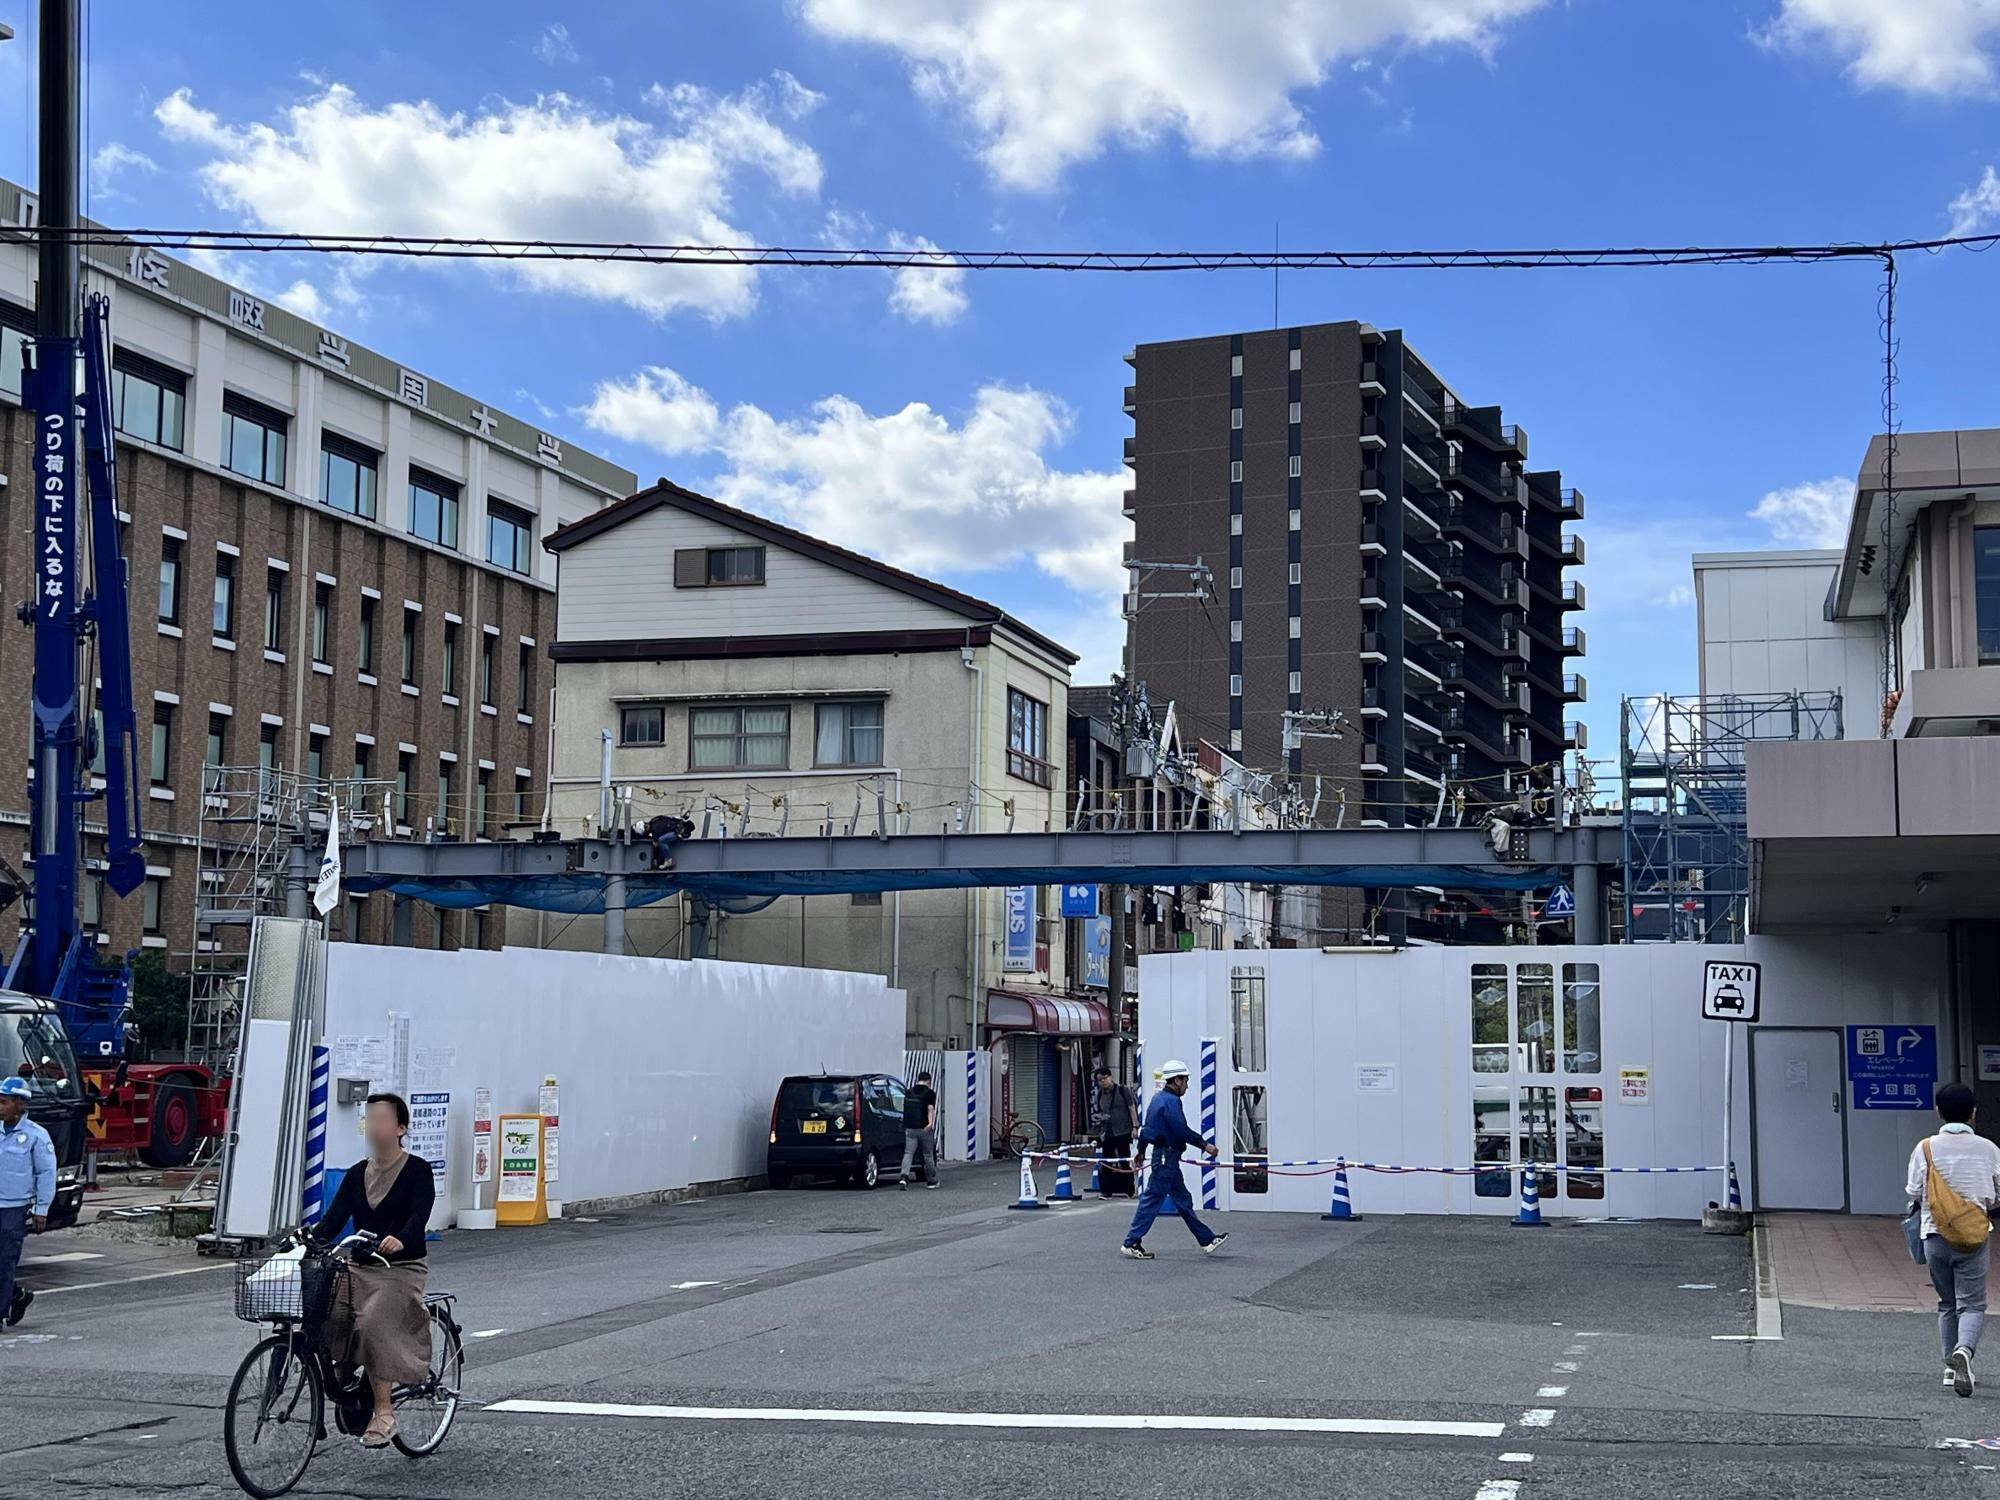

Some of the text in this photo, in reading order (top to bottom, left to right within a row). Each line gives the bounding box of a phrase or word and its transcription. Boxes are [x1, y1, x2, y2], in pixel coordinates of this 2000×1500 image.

[1710, 966, 1752, 982] TAXI
[1870, 1083, 1917, 1095] う回路
[511, 1145, 529, 1155] Go!
